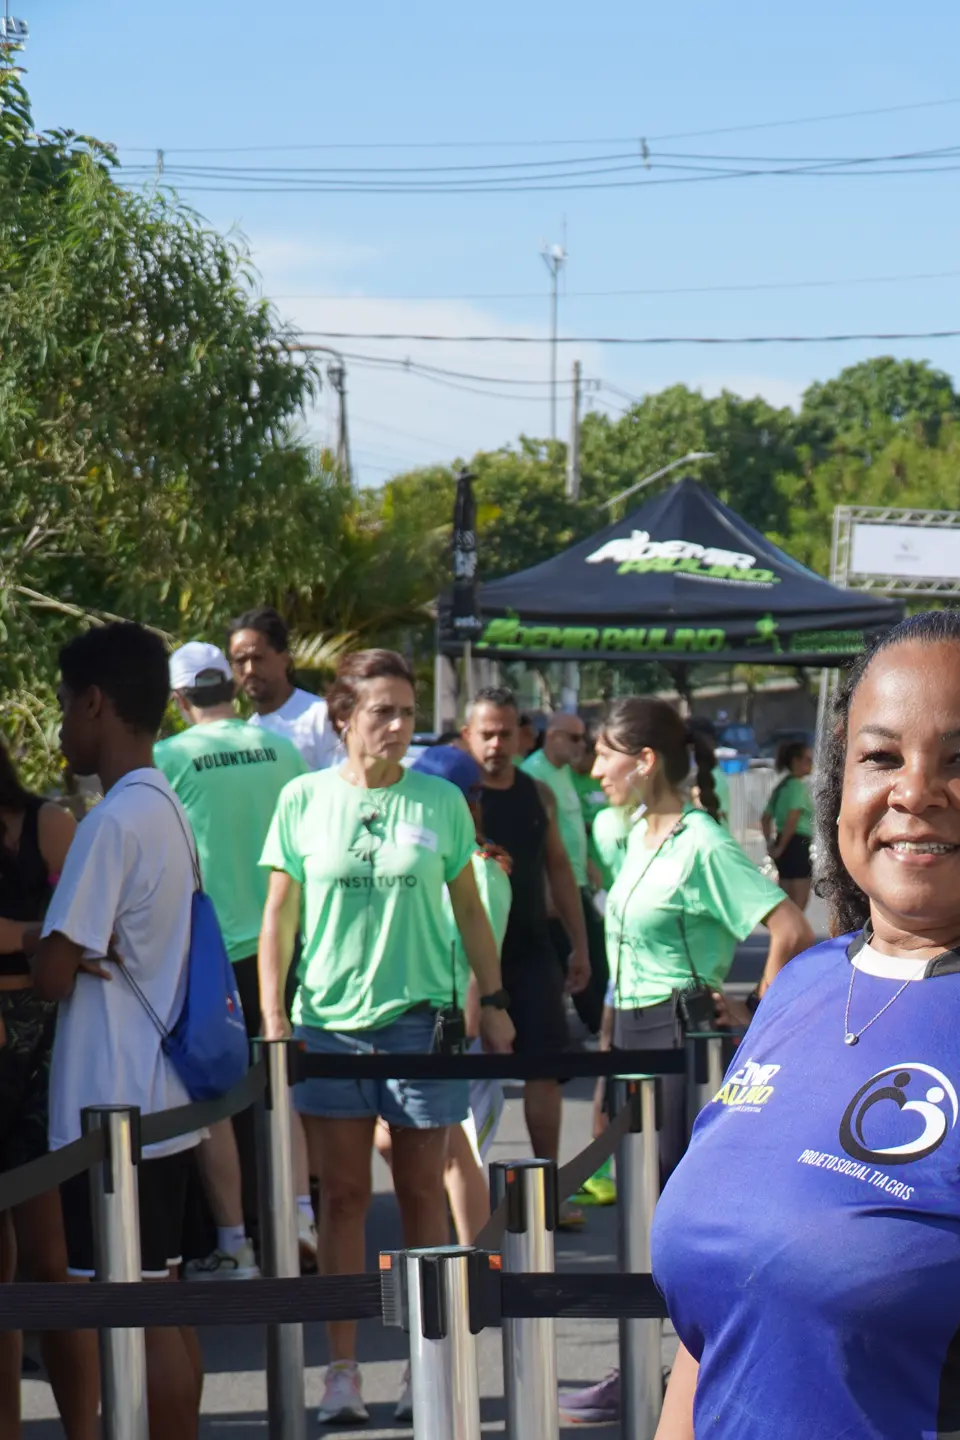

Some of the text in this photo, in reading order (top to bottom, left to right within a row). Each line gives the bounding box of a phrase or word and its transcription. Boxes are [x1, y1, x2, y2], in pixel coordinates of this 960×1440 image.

[334, 874, 418, 889] INSTITUTO
[797, 1149, 915, 1201] PROJETO SOCIAL TIA CRIS
